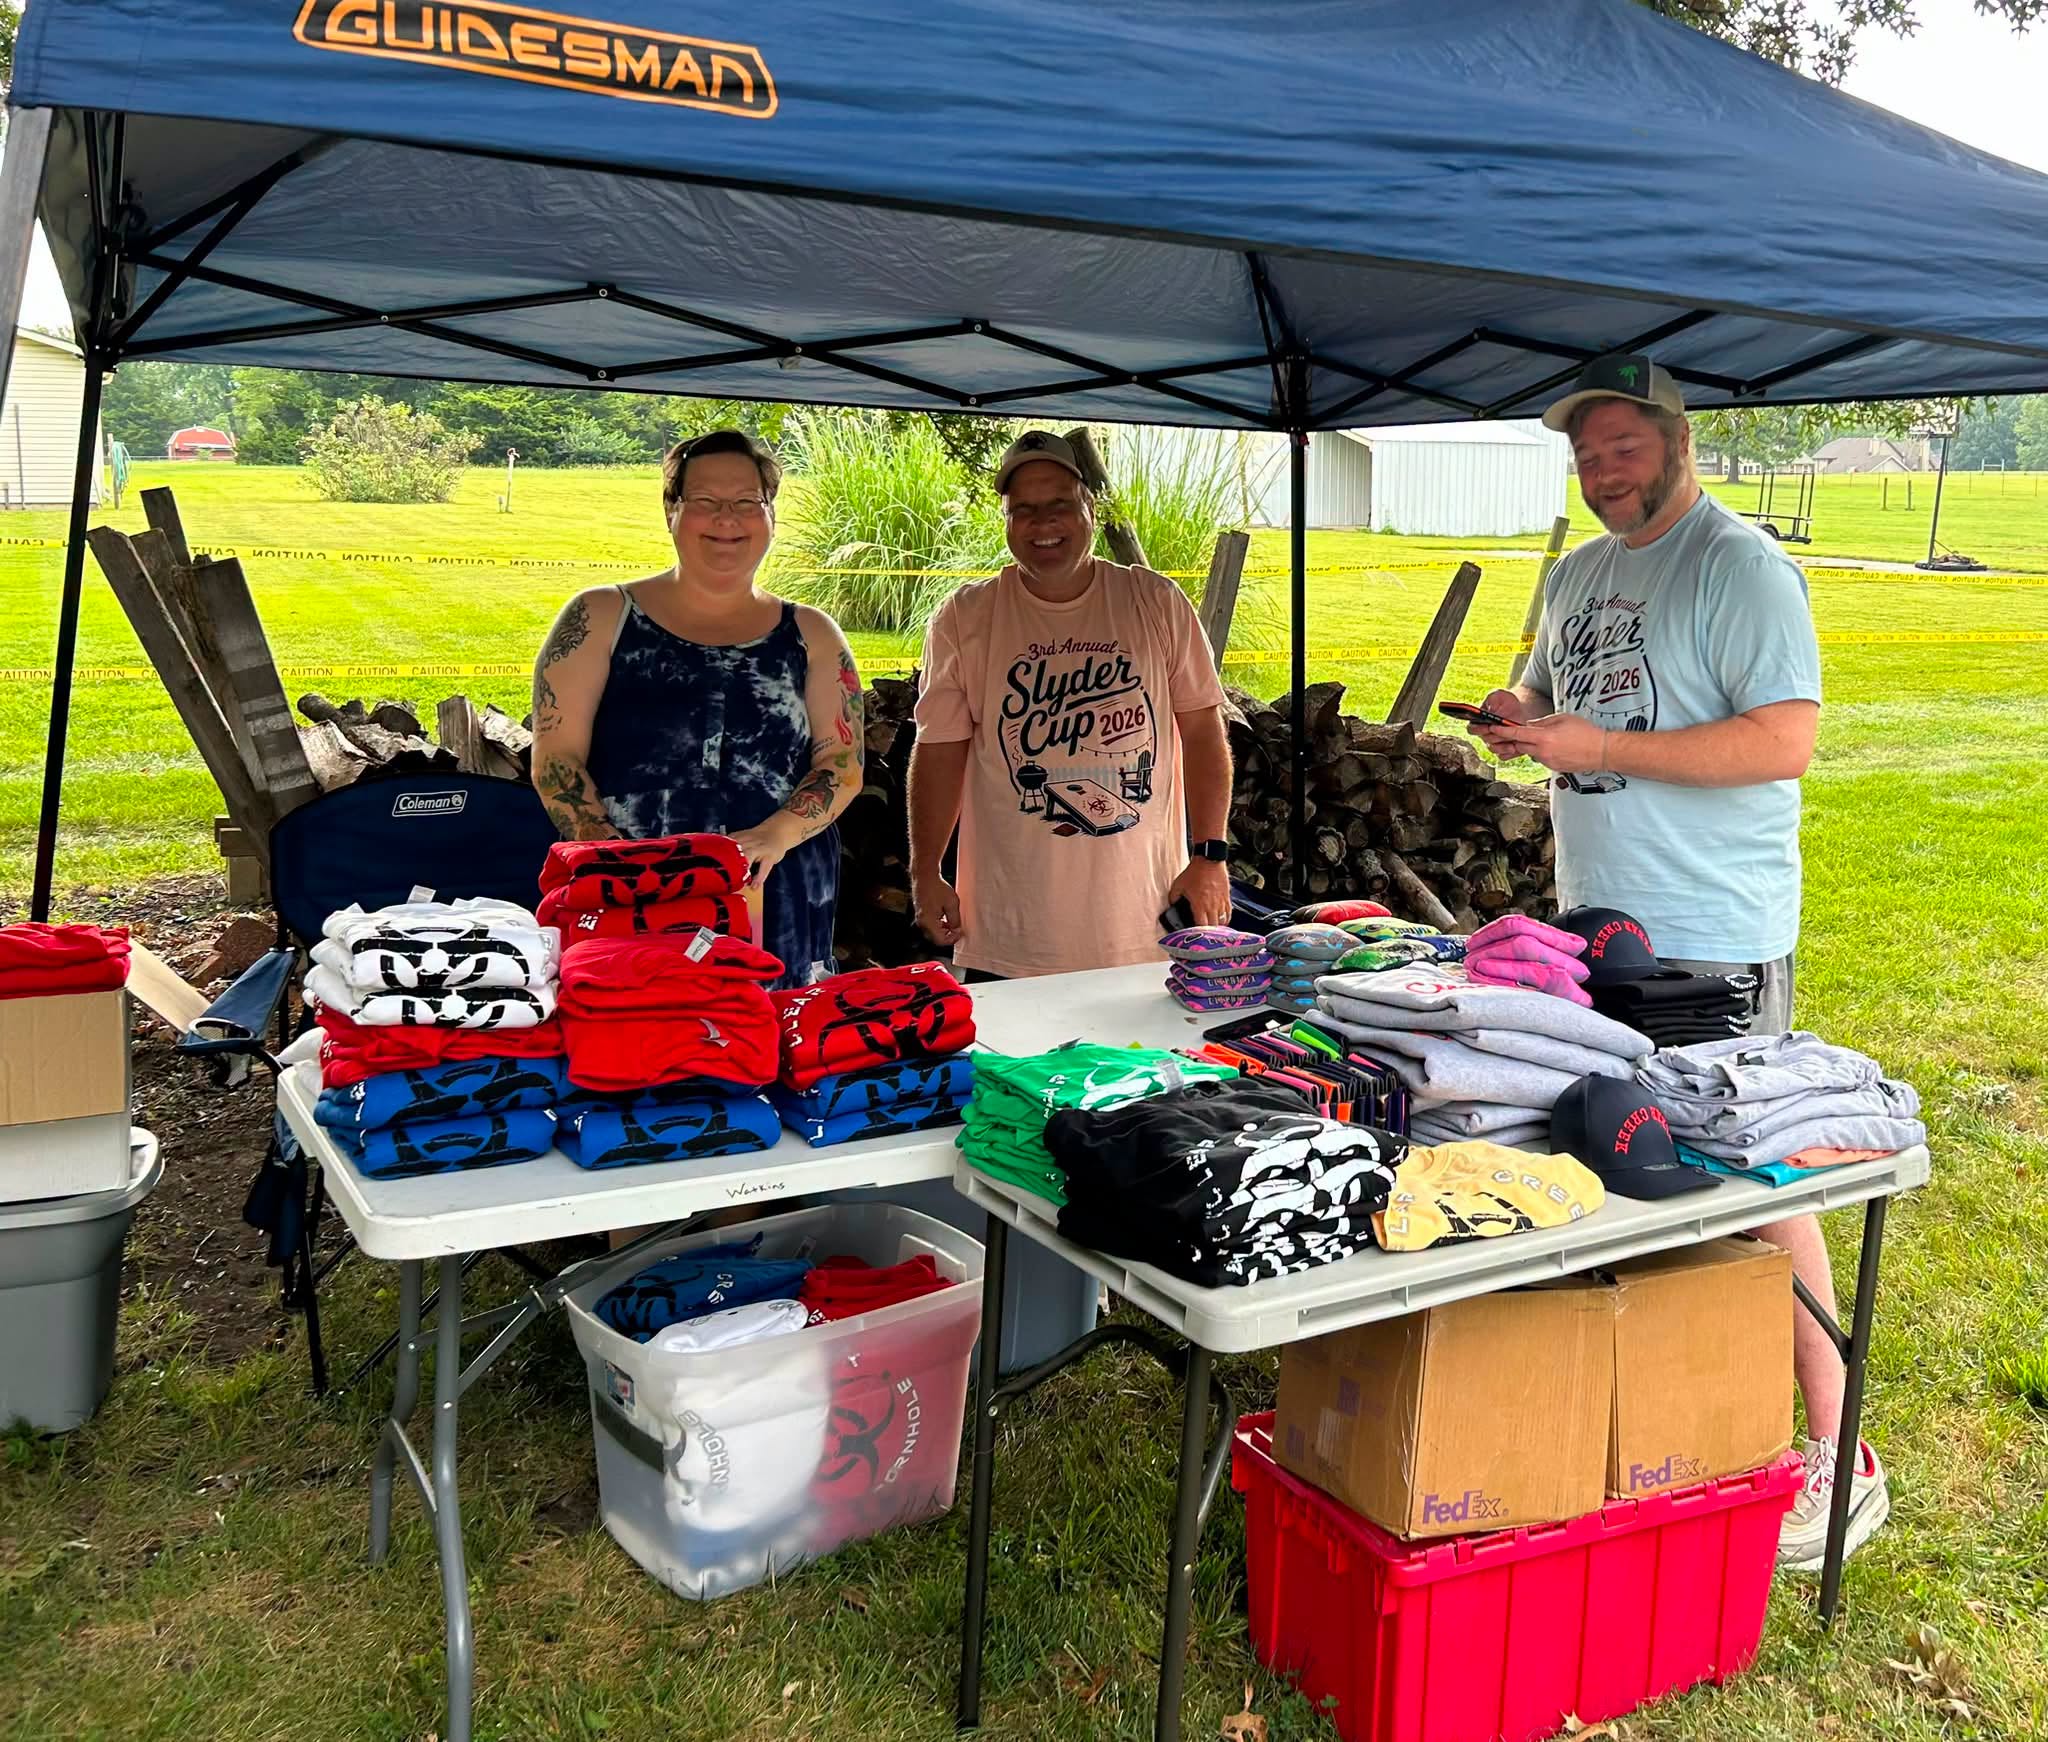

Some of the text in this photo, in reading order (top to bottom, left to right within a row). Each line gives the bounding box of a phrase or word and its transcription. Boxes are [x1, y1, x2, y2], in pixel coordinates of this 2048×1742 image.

[324, 0, 755, 103] GUIDESMAN
[1605, 593, 1646, 615] Annual
[1028, 637, 1119, 660] 3rd Annual
[1224, 651, 1291, 662] CAUTION CAUTIO
[1456, 646, 1478, 654] AUTION
[1551, 614, 1644, 671] Slyder
[281, 667, 333, 677] CAUTION
[347, 666, 398, 676] CAUTION
[412, 666, 461, 676] CAUTION
[474, 665, 521, 675] CAUTION
[862, 659, 902, 670] CAUTION
[1600, 668, 1640, 695] 2026
[1002, 655, 1142, 719] Slyder
[1020, 704, 1146, 757] Cup 2026
[399, 796, 450, 811] Coleman
[1591, 920, 1623, 959] CREEK
[1614, 1106, 1650, 1155] CREEK
[725, 1181, 786, 1199] Watkins
[1490, 1168, 1586, 1222] CREE
[873, 1377, 921, 1493] ORNHOLE
[1629, 1453, 1701, 1492] FedEx
[1422, 1489, 1501, 1524] FedEx
